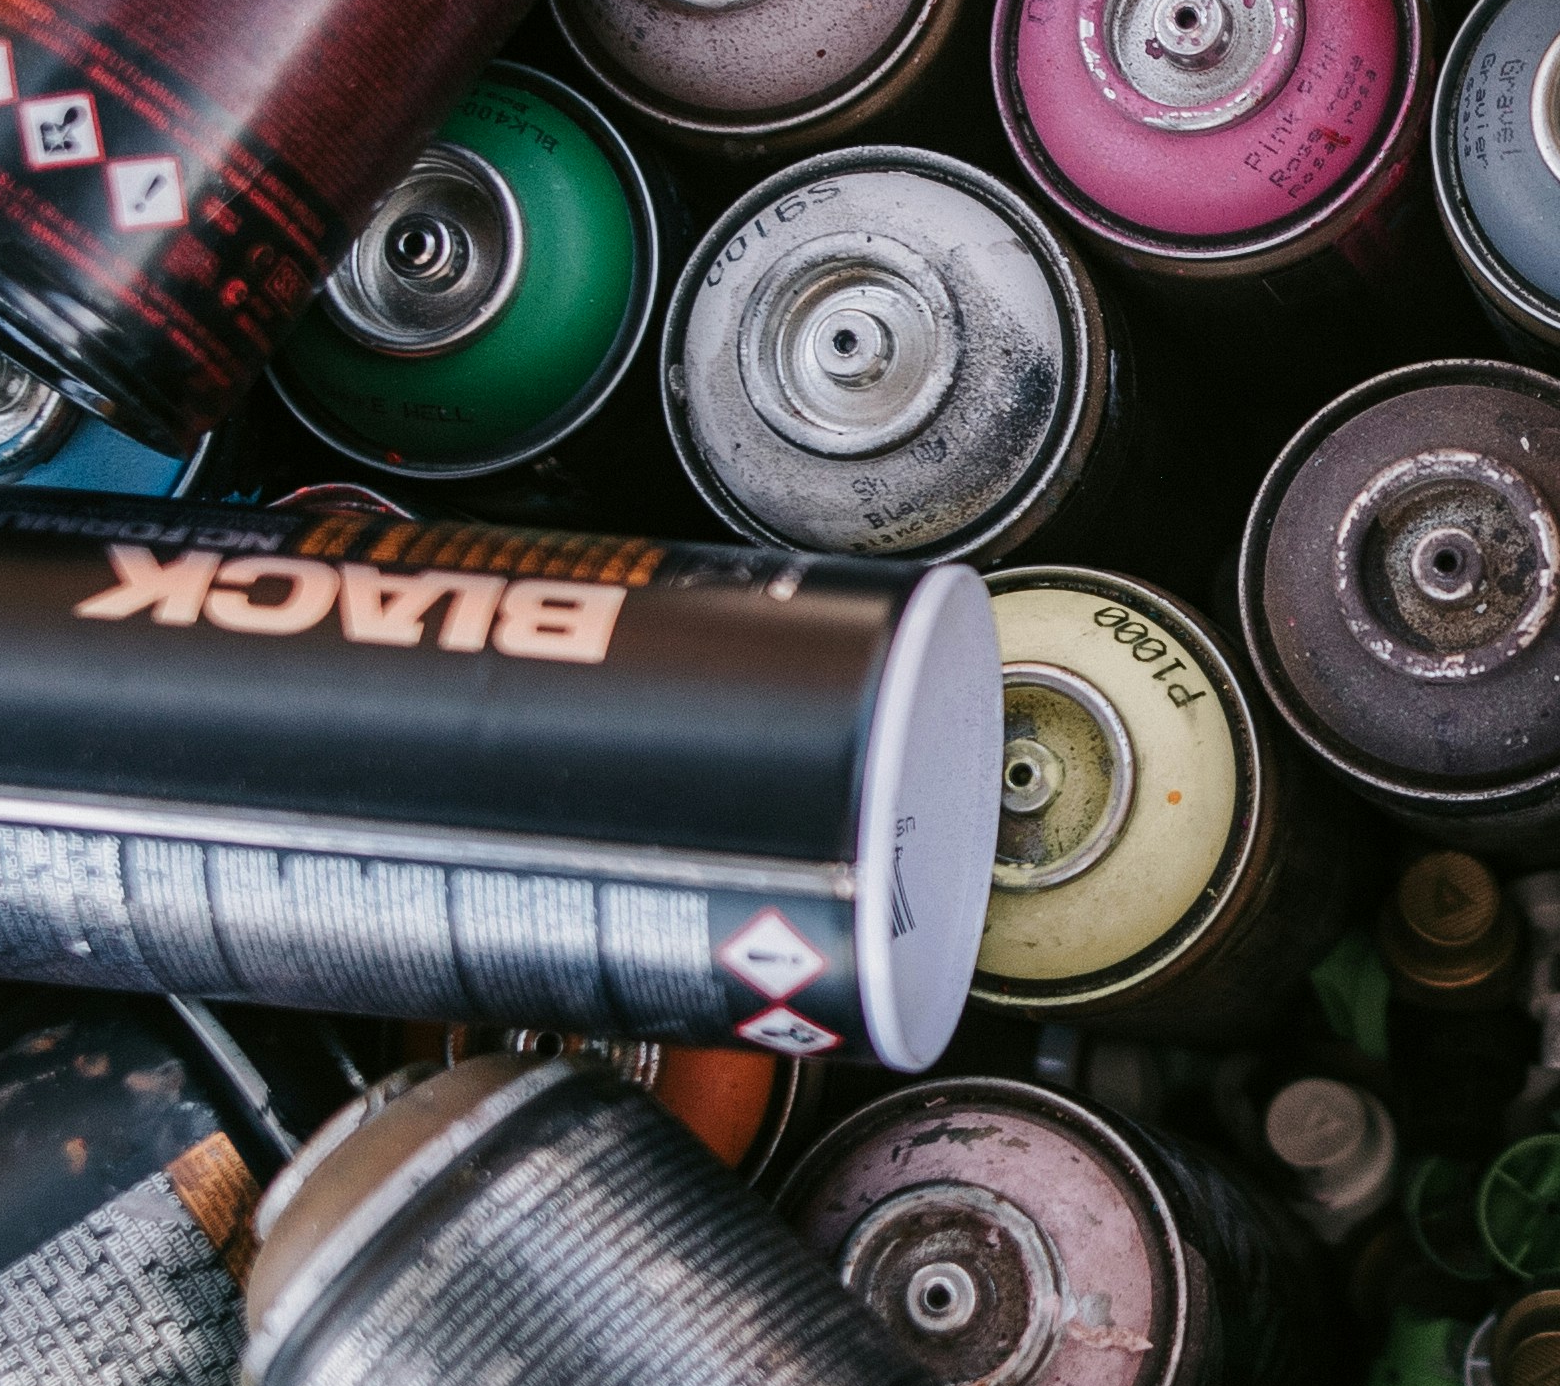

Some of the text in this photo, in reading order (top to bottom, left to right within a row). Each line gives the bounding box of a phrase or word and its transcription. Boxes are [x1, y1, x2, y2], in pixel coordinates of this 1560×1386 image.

[1474, 50, 1498, 171] Gravier
[1495, 55, 1528, 163] Gravel
[71, 541, 629, 665] BLACK
[1092, 604, 1208, 713] P1000
